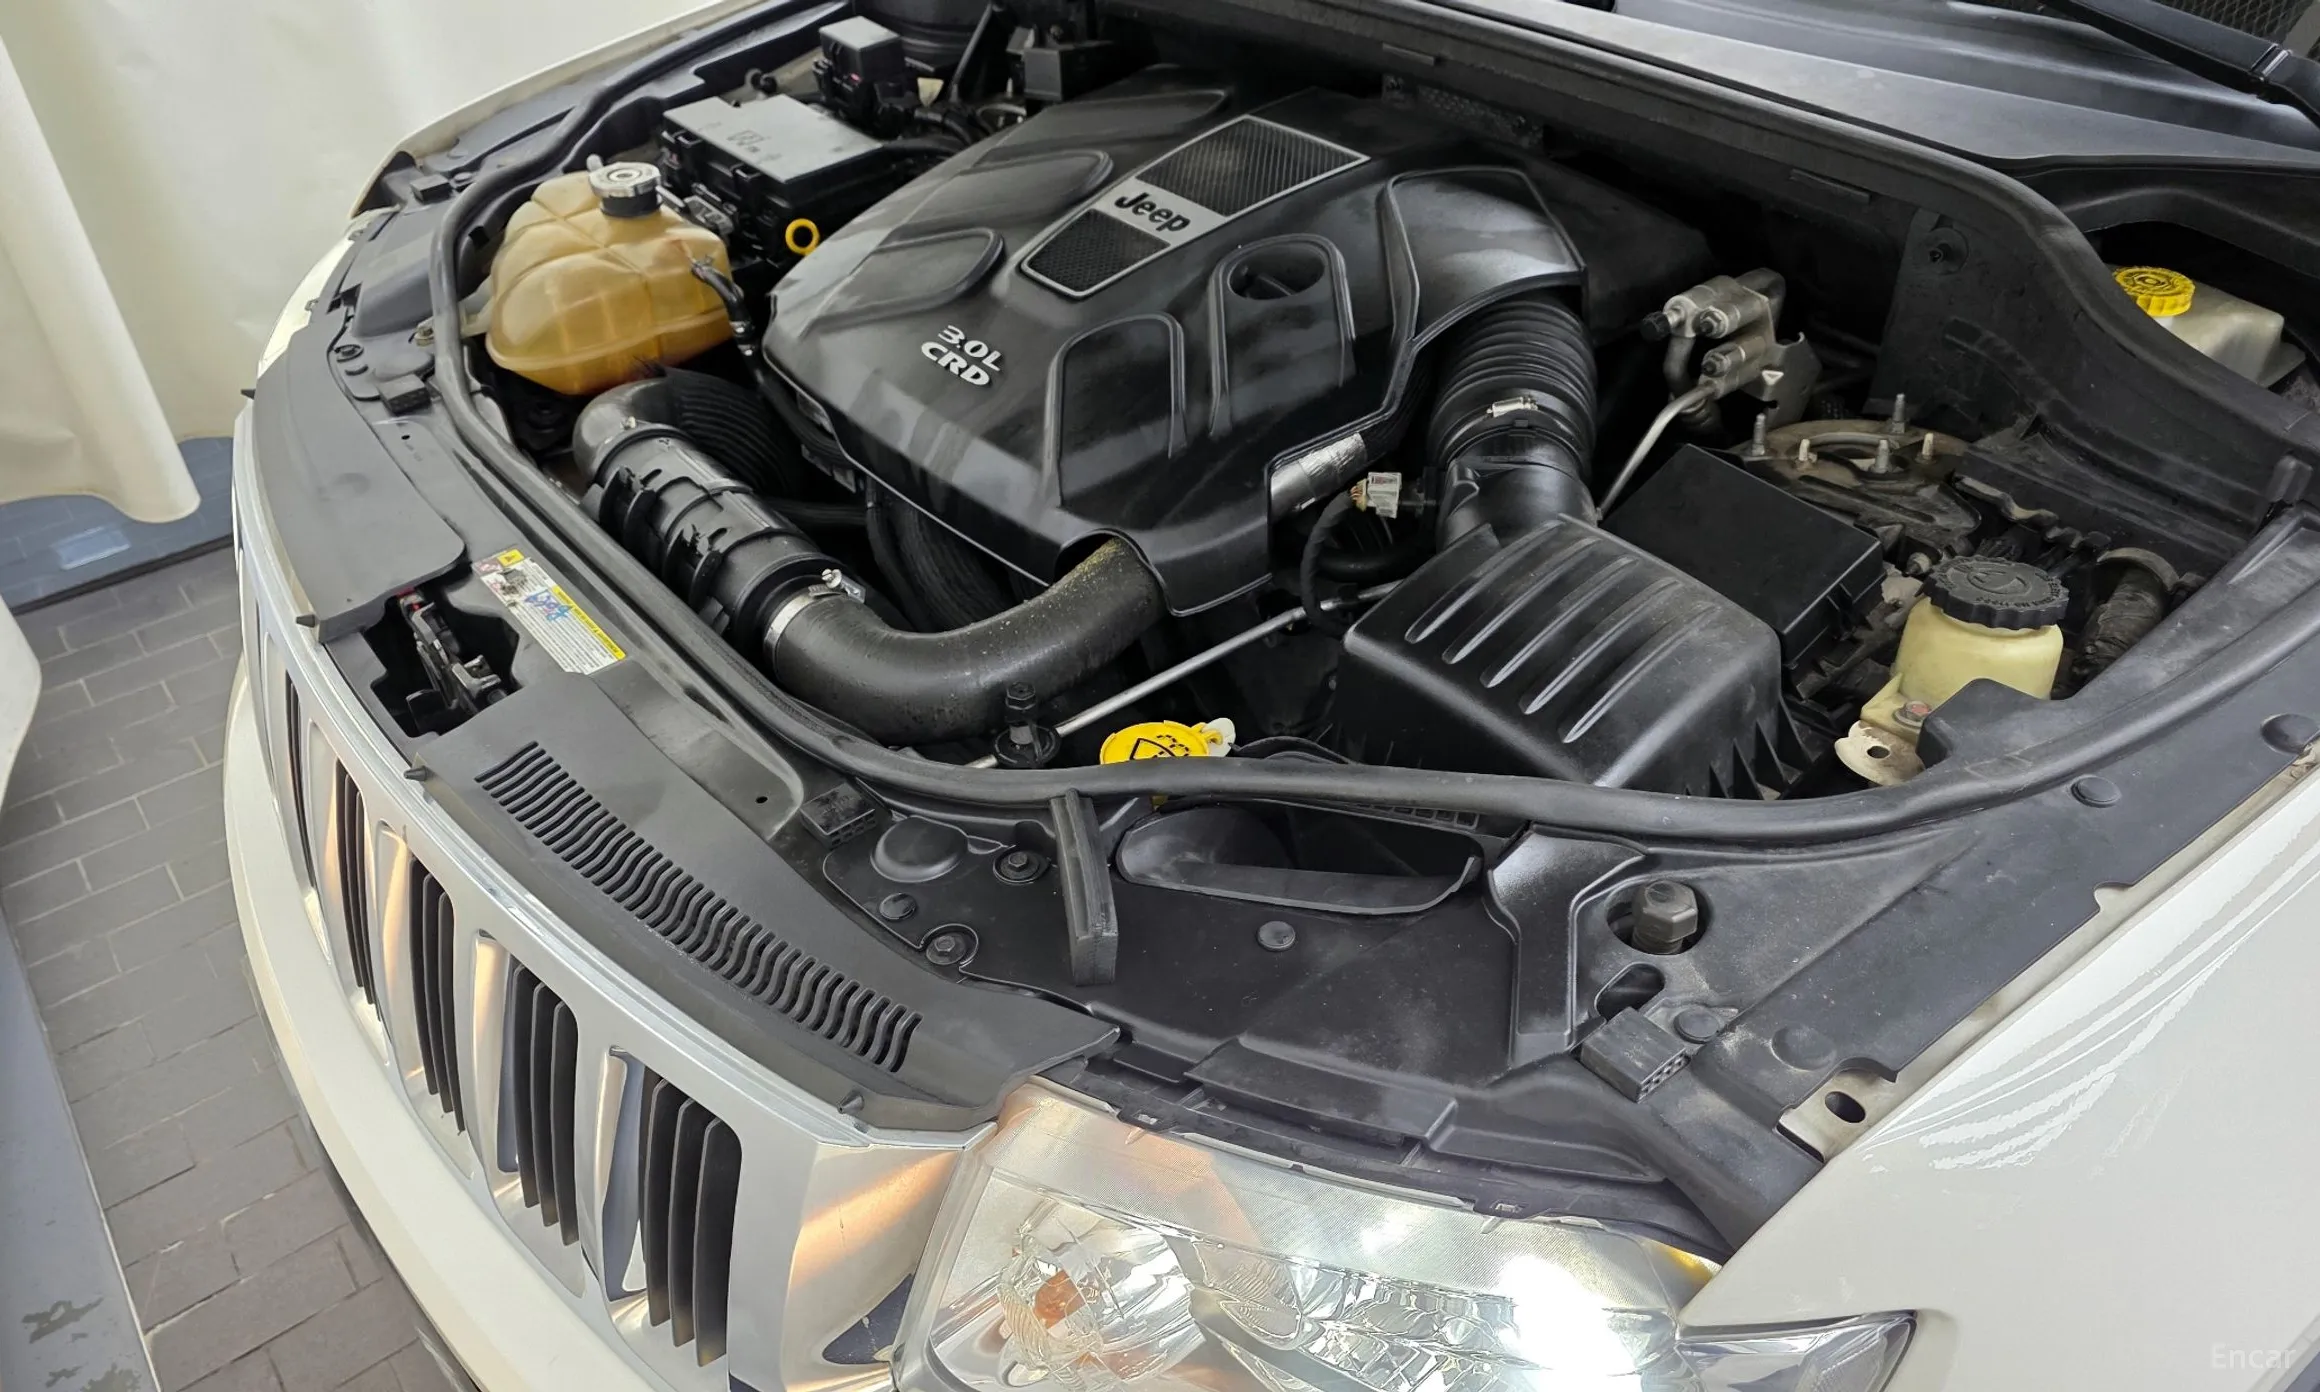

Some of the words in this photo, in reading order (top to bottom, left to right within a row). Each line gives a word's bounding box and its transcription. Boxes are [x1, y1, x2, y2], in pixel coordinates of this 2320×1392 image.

[1114, 192, 1191, 232] Jeep
[921, 342, 990, 385] CRD
[938, 325, 1001, 371] 3.0L
